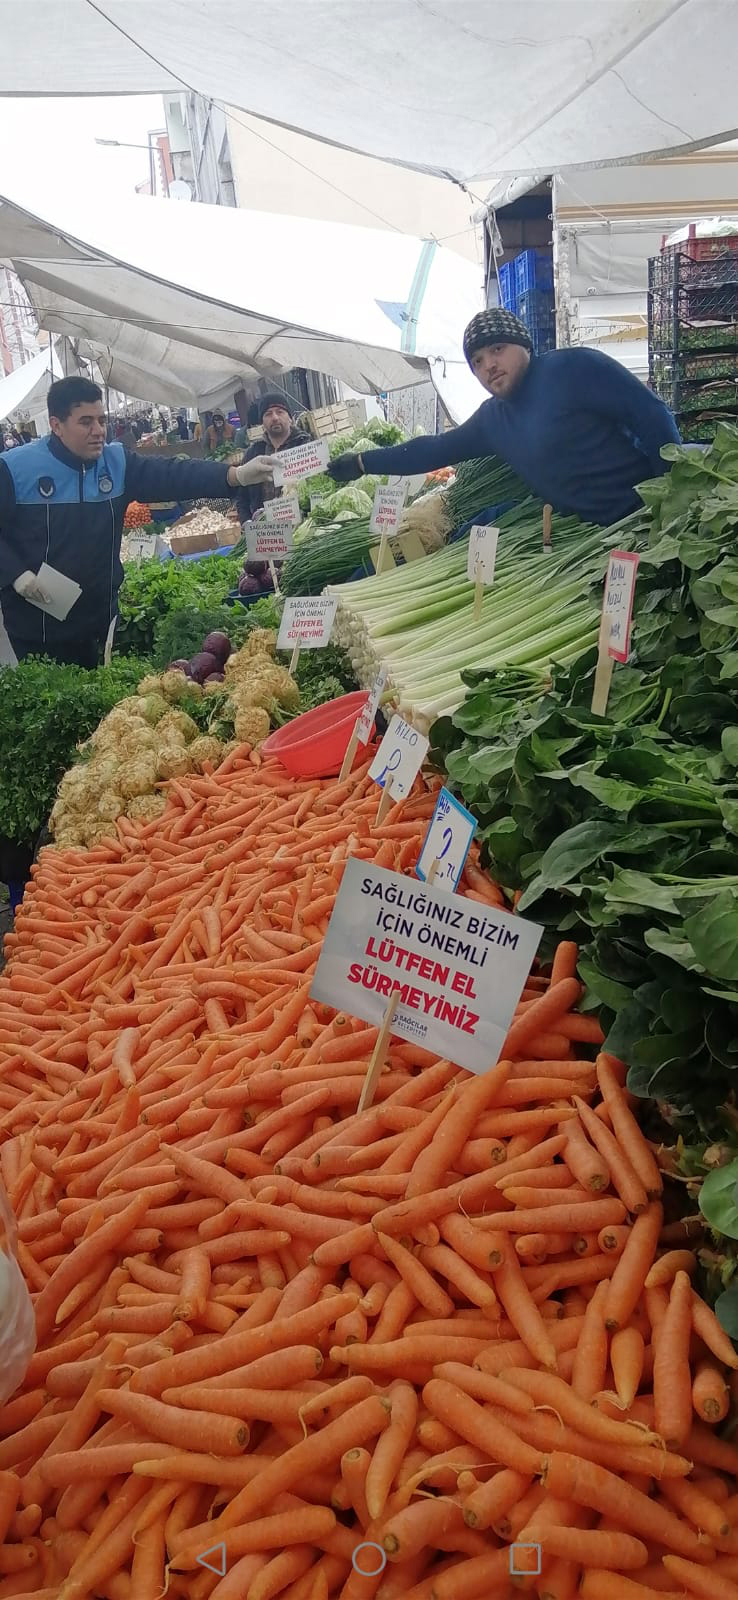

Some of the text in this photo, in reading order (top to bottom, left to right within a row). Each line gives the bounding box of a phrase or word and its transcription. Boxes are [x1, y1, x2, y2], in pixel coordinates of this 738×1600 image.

[291, 618, 324, 628] LÜTFEN EL
[360, 878, 520, 951] SAĞLIĞINIZ BİZİM
[375, 907, 489, 967] İÇİN ÖNEMLİ
[346, 963, 480, 1035] SÜRMEYİNİZ
[364, 936, 477, 1000] LÜTFEN EL
[399, 1015, 428, 1032] BAĞCILAR
